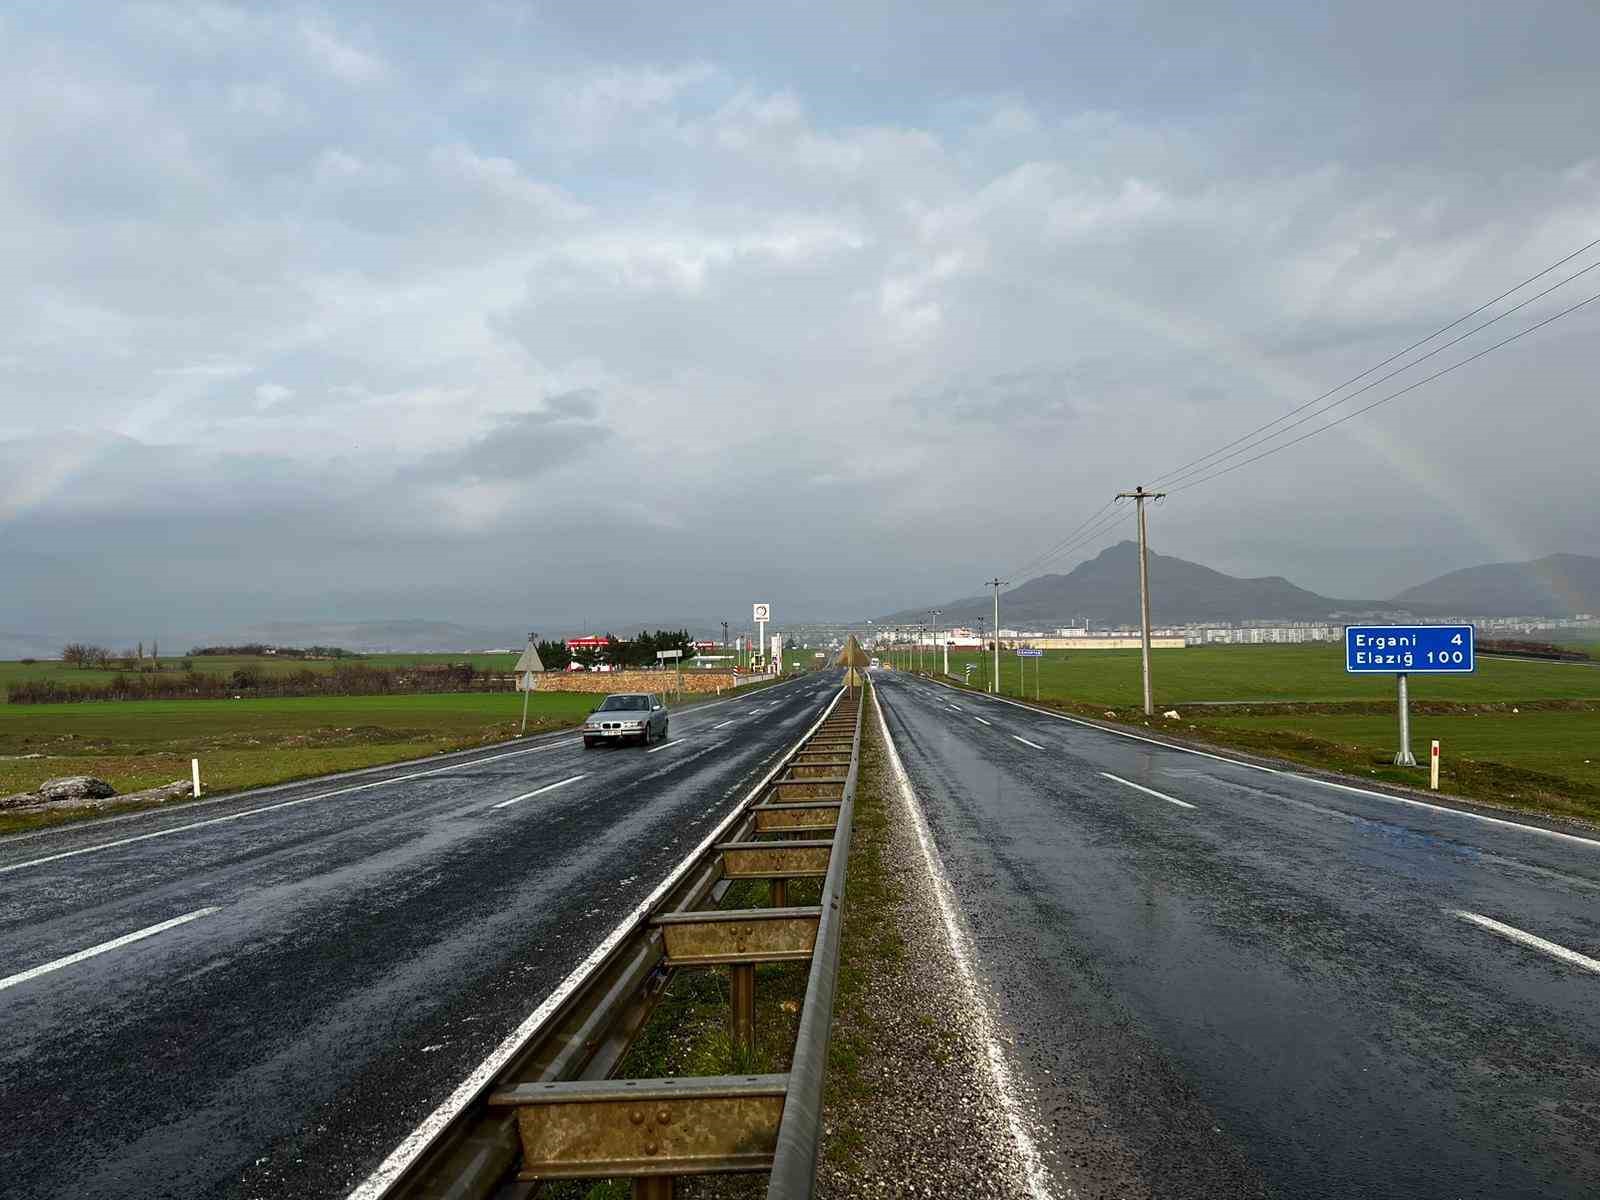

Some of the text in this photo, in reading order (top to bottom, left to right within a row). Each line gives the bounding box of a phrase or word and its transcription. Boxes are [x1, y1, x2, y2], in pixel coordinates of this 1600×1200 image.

[1356, 633, 1463, 649] Ergani 4
[1356, 651, 1463, 666] Elazığ 100
